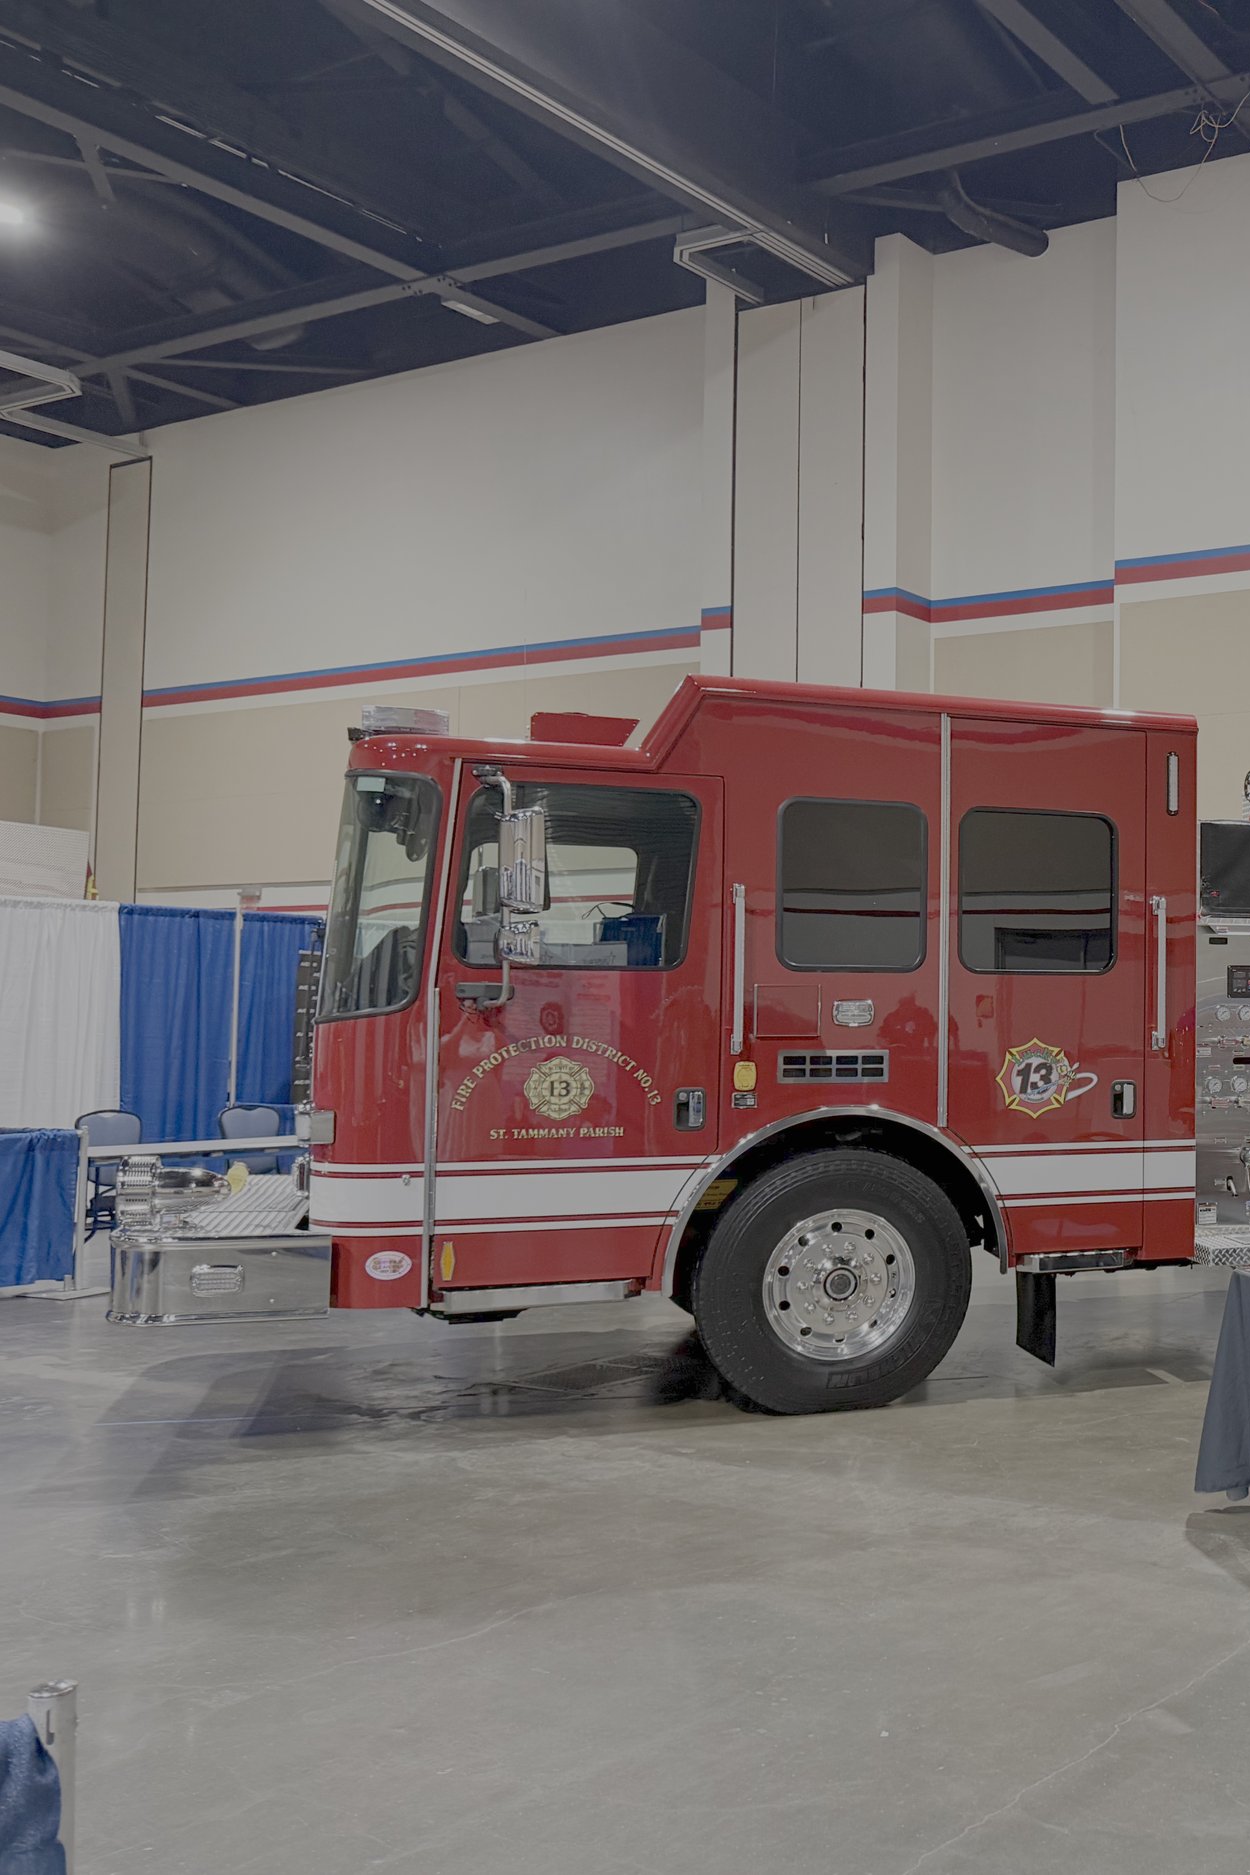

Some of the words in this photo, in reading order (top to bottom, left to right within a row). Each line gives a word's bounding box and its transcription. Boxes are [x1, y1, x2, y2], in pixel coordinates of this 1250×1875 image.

[451, 1076, 477, 1111] FIRE
[472, 1035, 567, 1079] PROTECTION
[572, 1036, 637, 1071] DISTRICT
[1016, 1062, 1053, 1094] 13
[550, 1080, 571, 1097] 13
[489, 1129, 508, 1140] ST.
[511, 1127, 577, 1139] TAMMANY
[579, 1126, 624, 1138] PARISH
